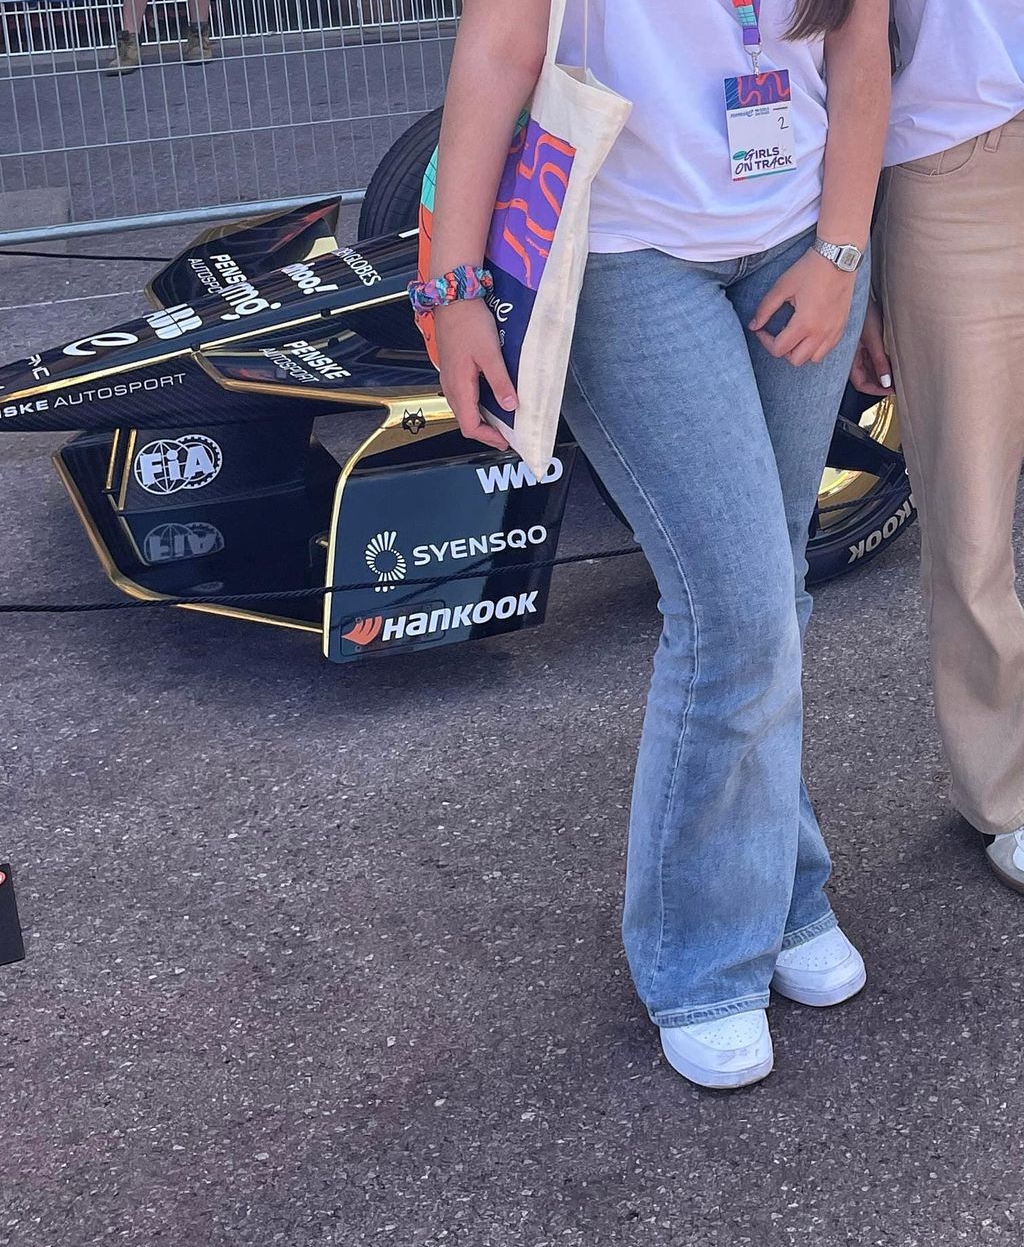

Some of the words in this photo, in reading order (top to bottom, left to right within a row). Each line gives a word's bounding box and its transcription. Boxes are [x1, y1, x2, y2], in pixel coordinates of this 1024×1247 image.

[777, 116, 789, 130] 2
[735, 160, 753, 175] ON
[754, 155, 792, 170] TRACK
[744, 147, 780, 163] GIRLS
[210, 254, 248, 285] PENS
[259, 347, 320, 385] AUTOSPORT
[283, 340, 352, 381] PENSKE
[53, 372, 187, 409] AUTOSPORT
[412, 524, 548, 566] SYENSQO
